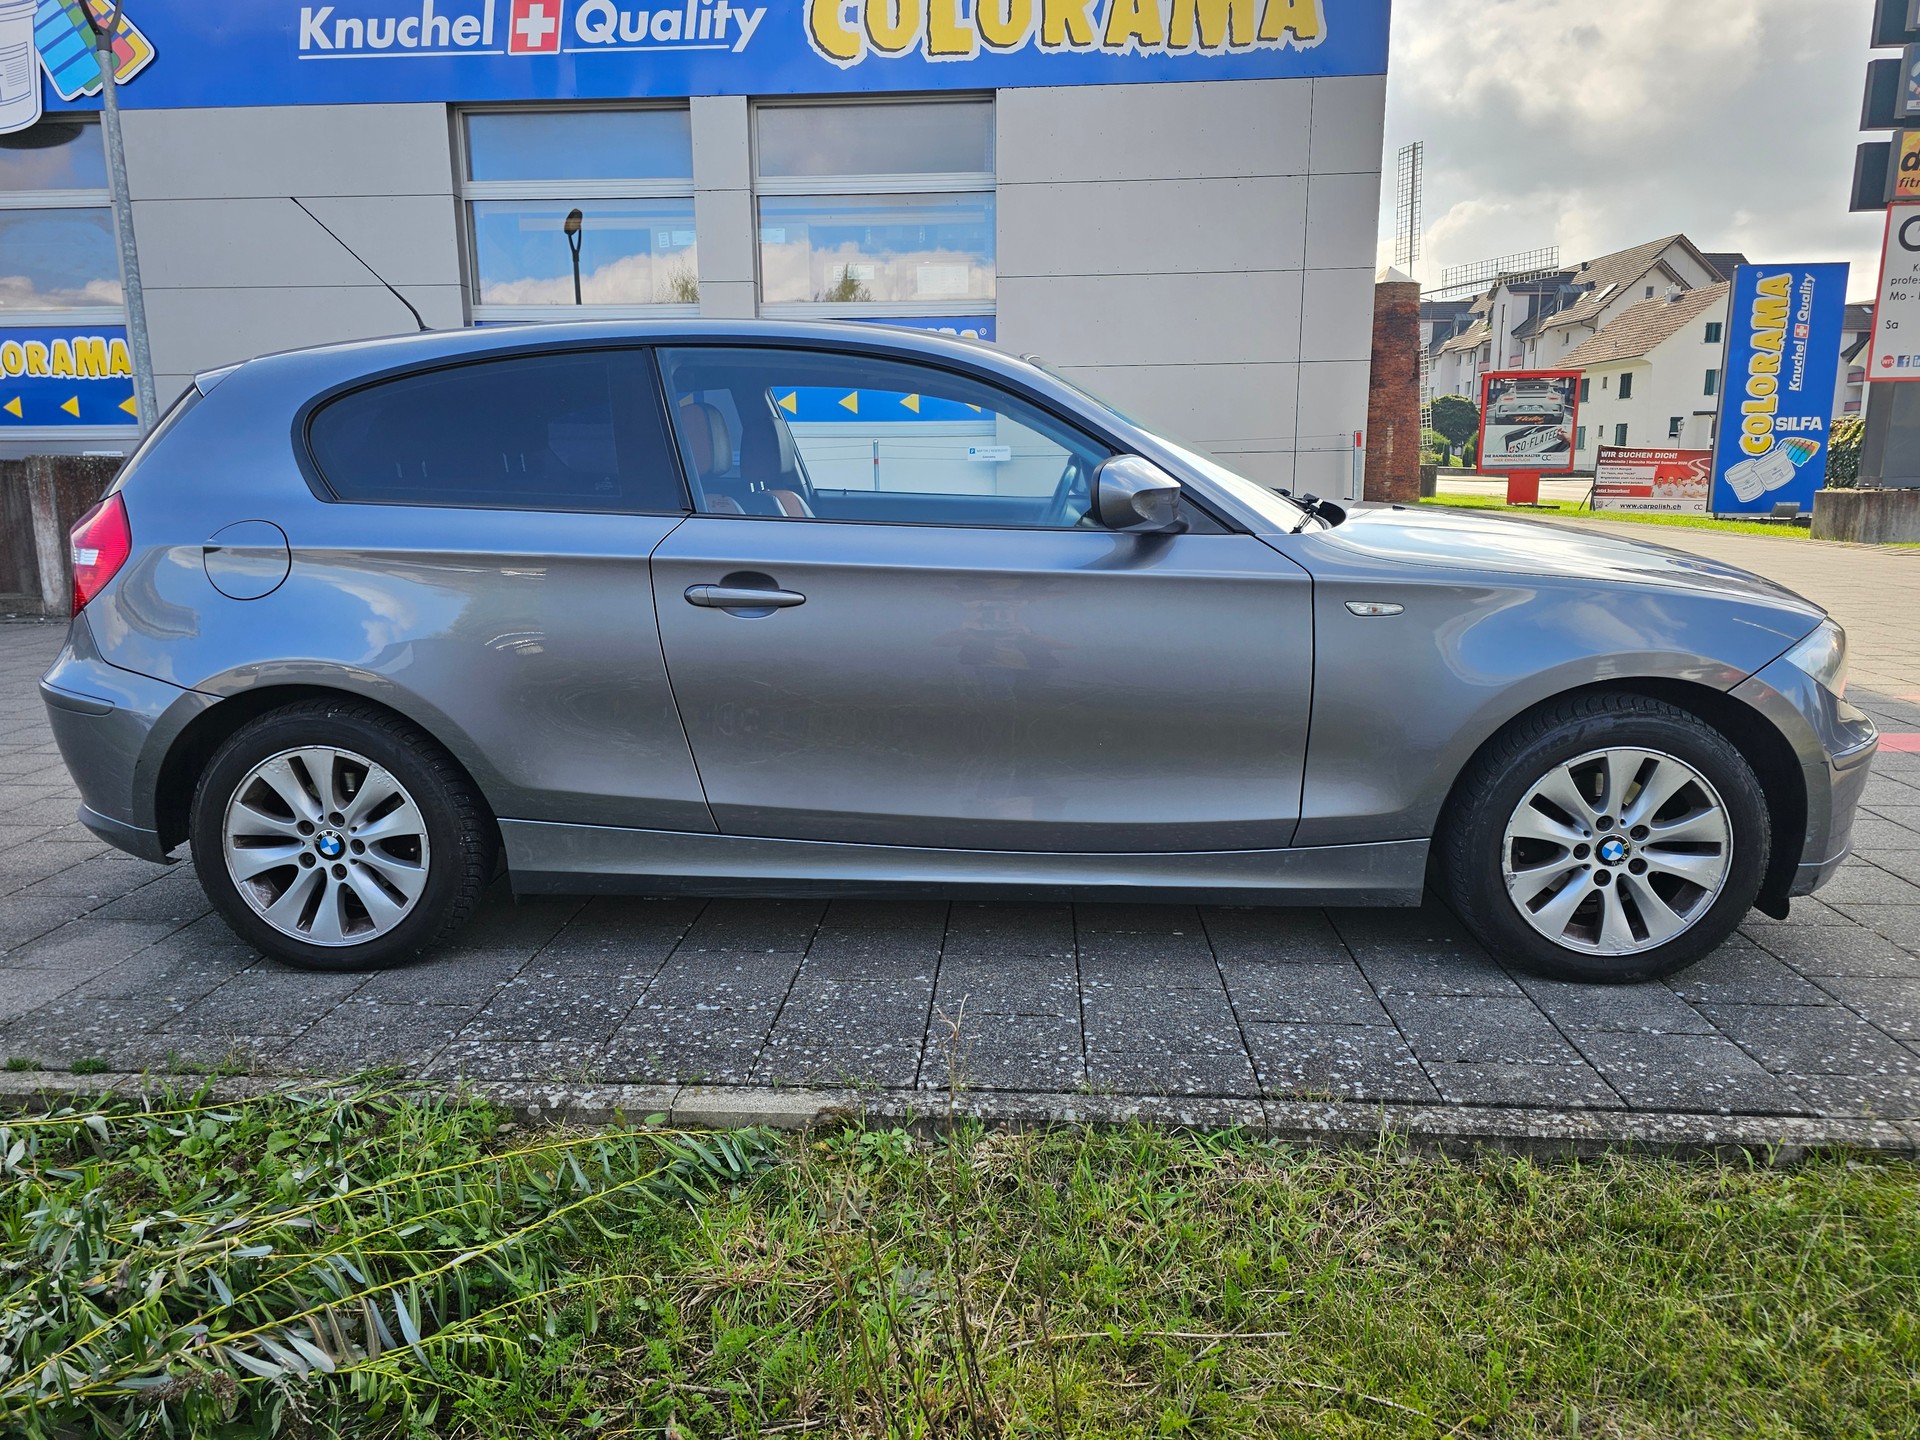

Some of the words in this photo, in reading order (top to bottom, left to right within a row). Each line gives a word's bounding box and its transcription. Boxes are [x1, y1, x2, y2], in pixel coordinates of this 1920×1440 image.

[299, 0, 495, 51] Knuchel
[575, 0, 768, 53] Quality
[1889, 292, 1907, 301] Mo
[1788, 340, 1805, 392] Knuchel
[1797, 273, 1816, 322] Quality
[1885, 319, 1899, 330] Sa
[0, 337, 132, 380] ORAMA
[1739, 272, 1793, 456] COLORAMA
[1775, 416, 1822, 431] SILFA
